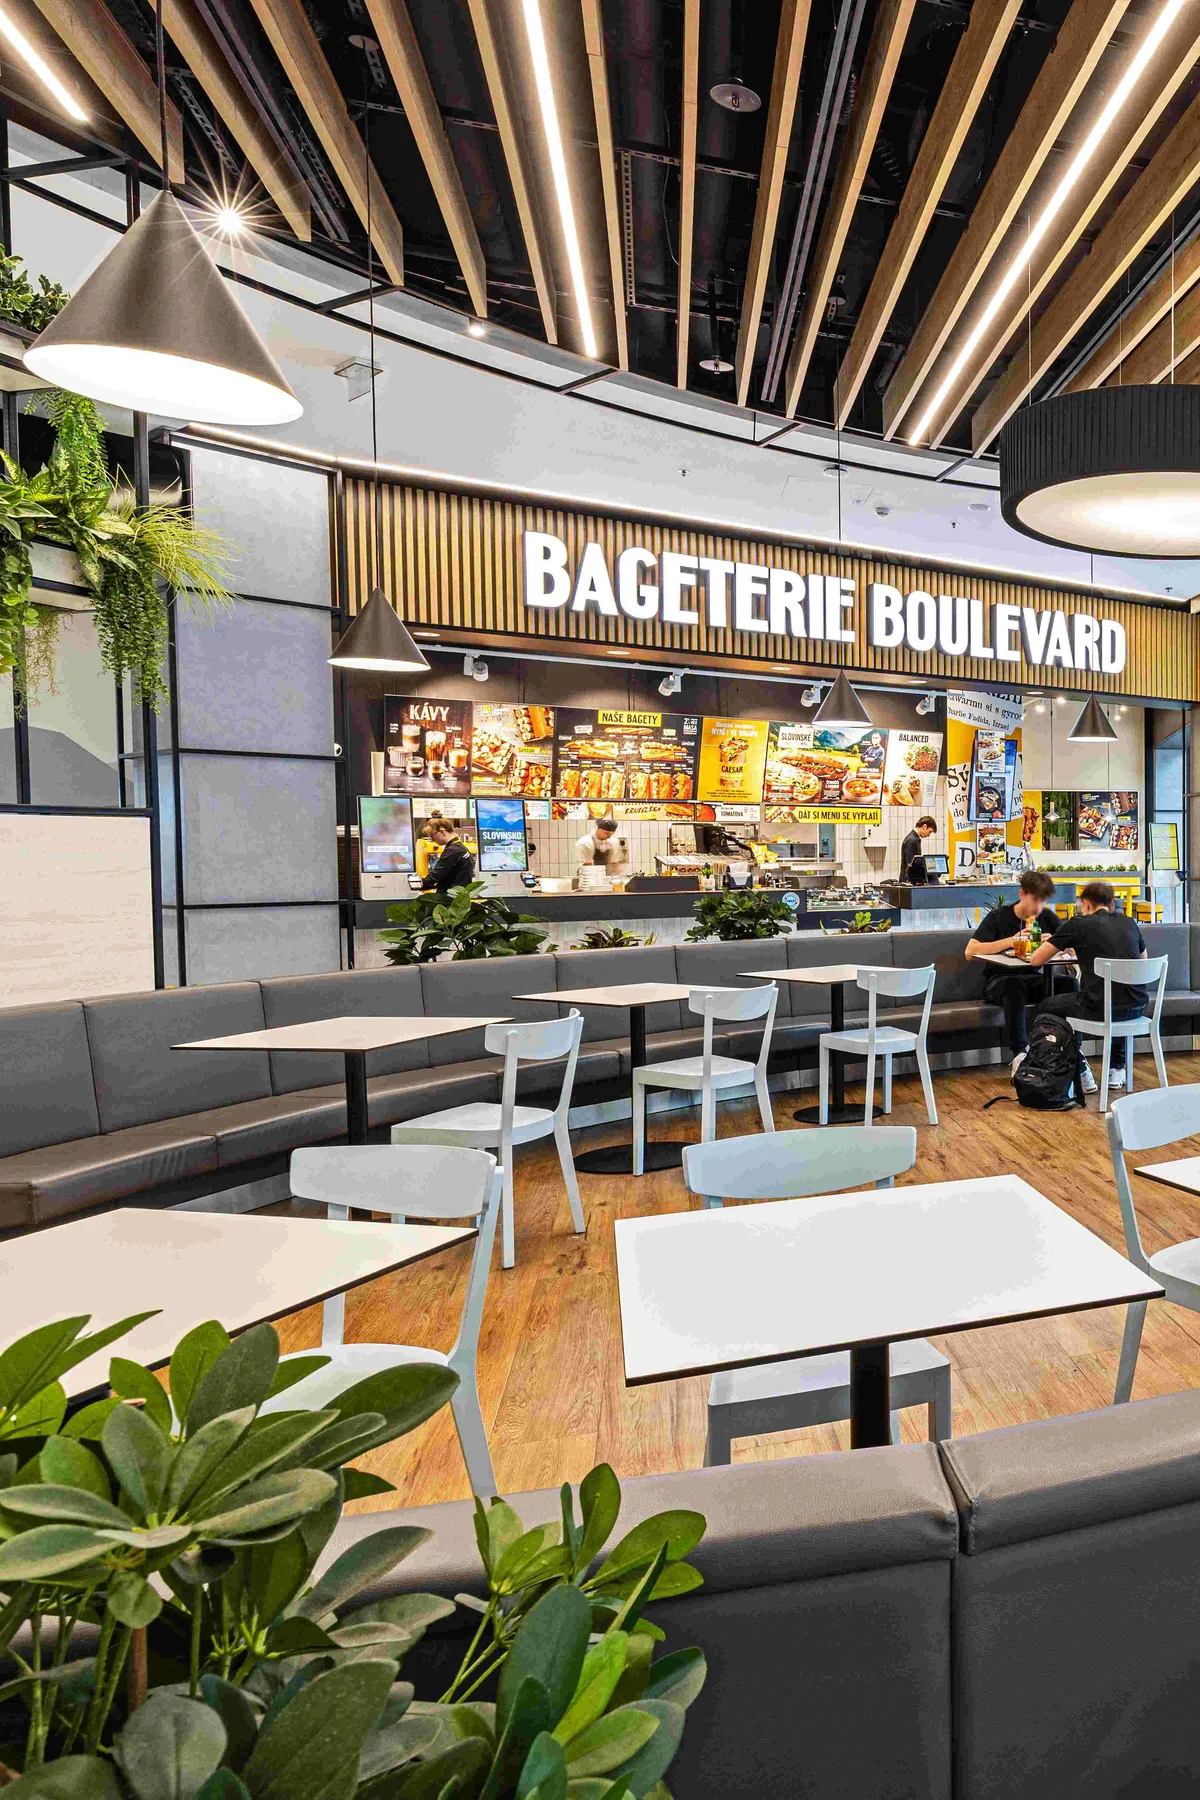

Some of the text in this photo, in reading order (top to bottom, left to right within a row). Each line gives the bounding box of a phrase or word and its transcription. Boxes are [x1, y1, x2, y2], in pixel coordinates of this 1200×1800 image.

[523, 530, 1127, 674] BAGETERIE BOULEVARD
[409, 702, 450, 722] KÁVY
[947, 707, 966, 718] harlie
[985, 703, 993, 713] si
[602, 711, 658, 725] NAŠE BAGETY
[781, 732, 812, 742] SLOVINSKÉ
[898, 733, 929, 743] BALANCED
[721, 765, 744, 774] CAESAR
[798, 809, 879, 821] DÁT SI MENU SE VYPLATÍ
[482, 831, 522, 840] SLOVINSKO
